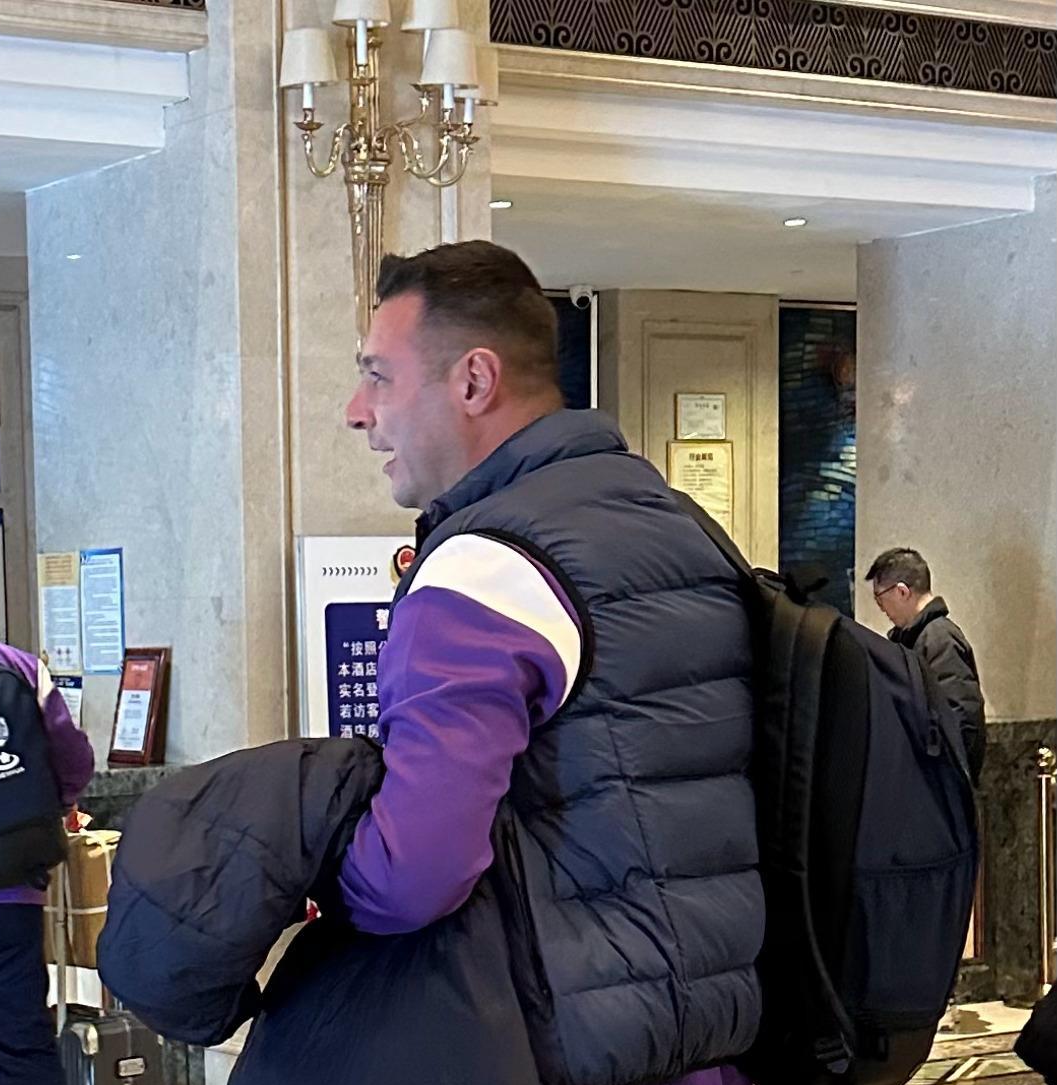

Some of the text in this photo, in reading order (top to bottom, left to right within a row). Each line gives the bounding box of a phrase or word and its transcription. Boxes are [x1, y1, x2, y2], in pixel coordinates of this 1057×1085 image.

[338, 662, 378, 676] 本酒店
[339, 682, 379, 698] 实名登
[339, 703, 379, 719] 若访客
